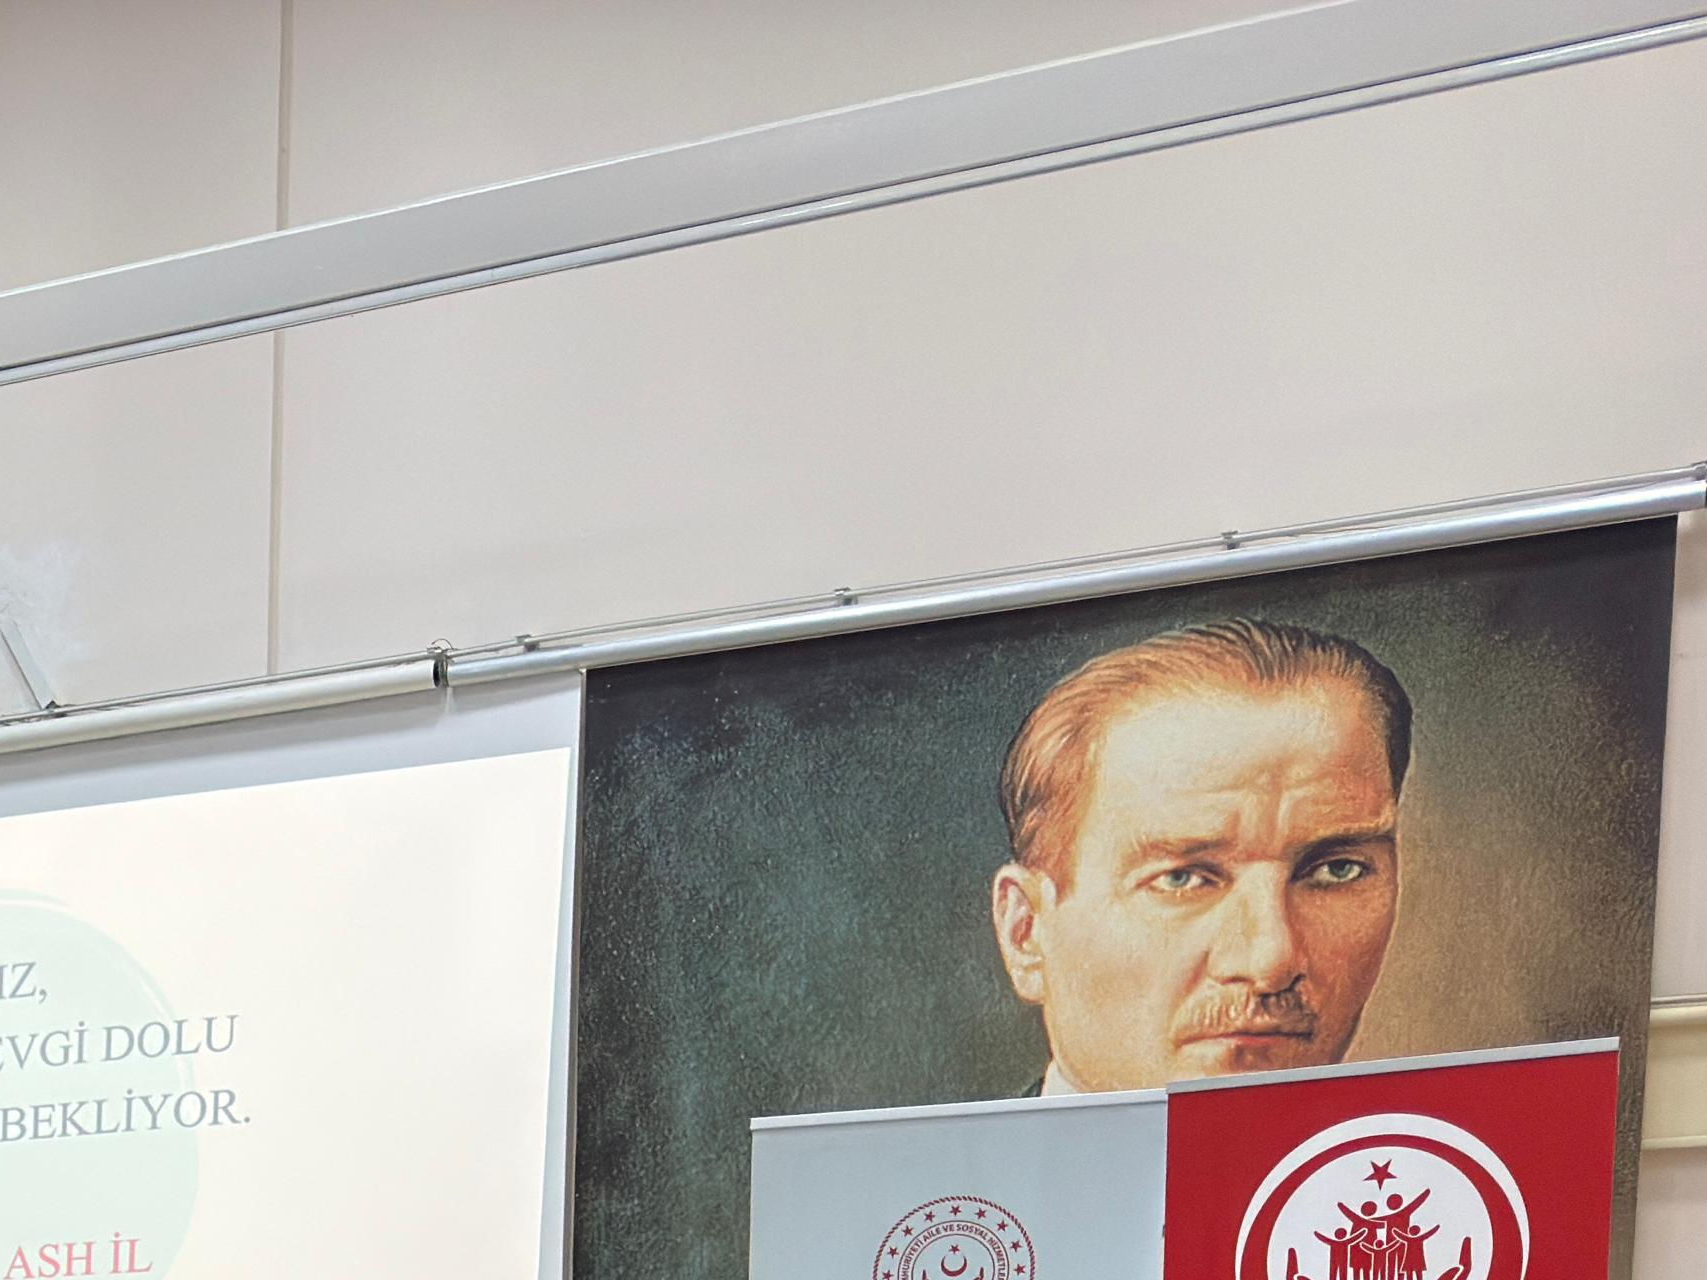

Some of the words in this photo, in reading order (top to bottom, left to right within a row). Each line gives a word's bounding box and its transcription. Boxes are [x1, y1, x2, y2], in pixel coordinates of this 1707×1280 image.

[101, 1014, 239, 1061] DOLU
[0, 1089, 251, 1143] BEKLİYOR.
[4, 1241, 96, 1280] ASH
[110, 1232, 153, 1273] İL
